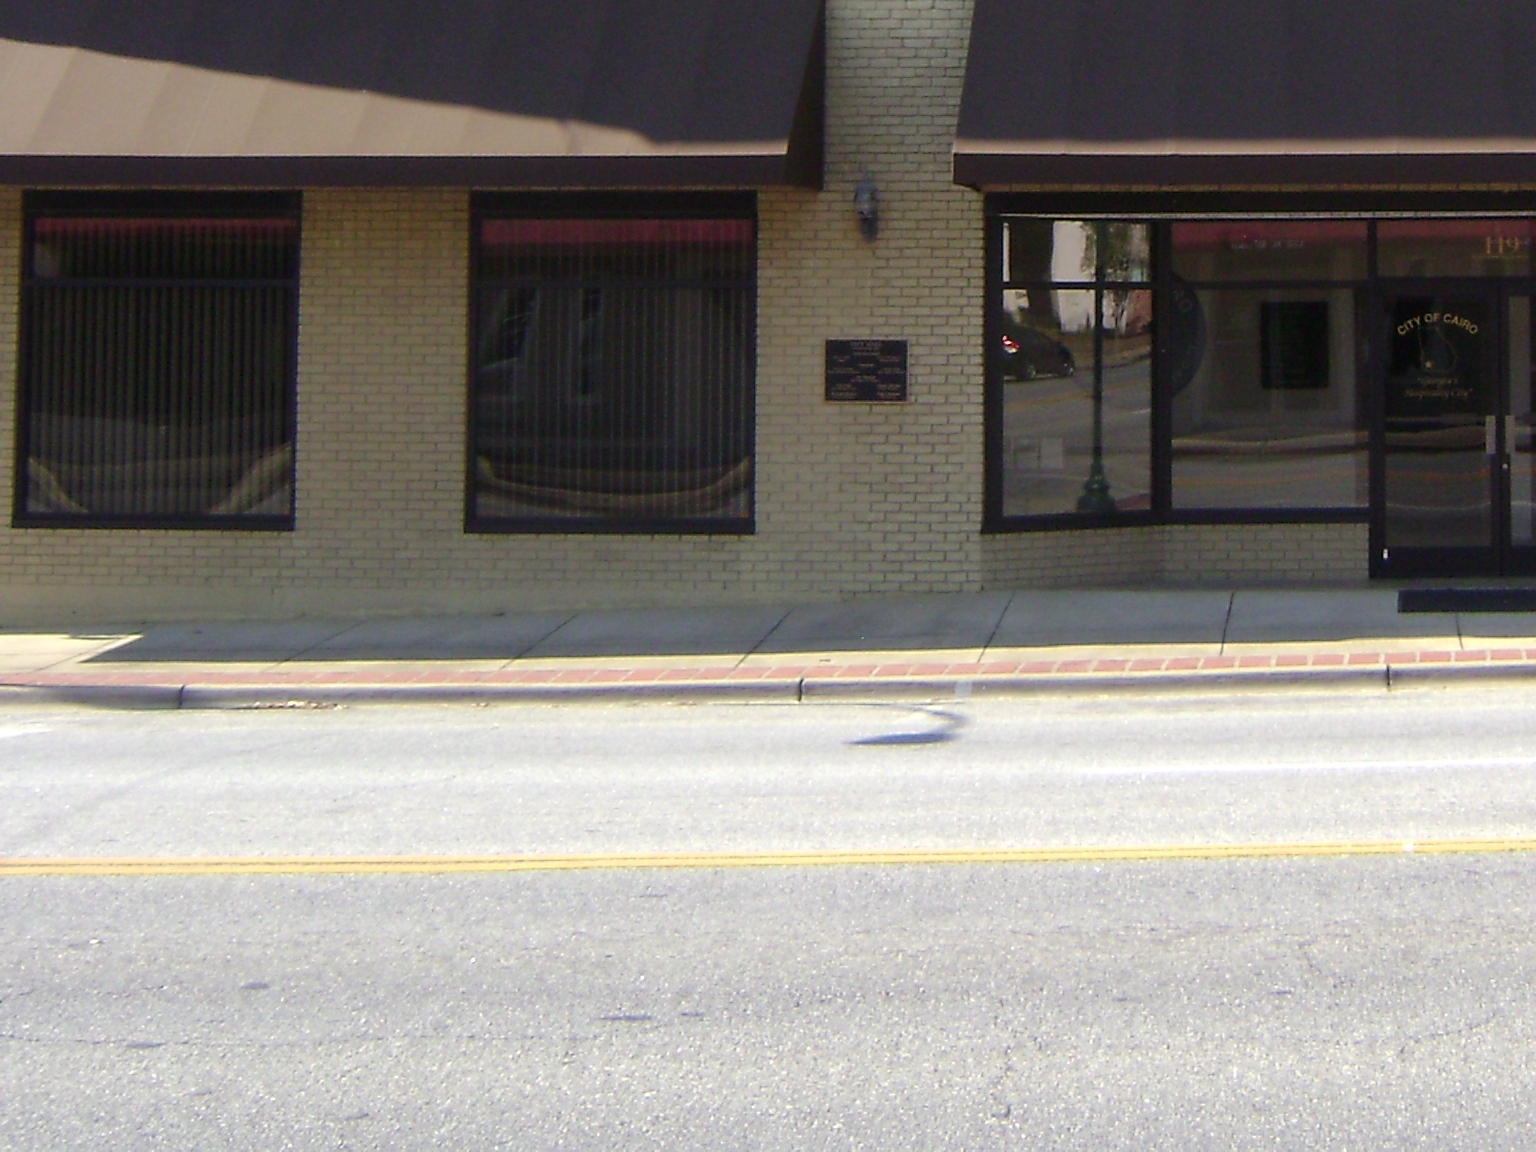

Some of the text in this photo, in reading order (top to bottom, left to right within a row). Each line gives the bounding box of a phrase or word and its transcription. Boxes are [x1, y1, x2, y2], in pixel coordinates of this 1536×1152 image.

[1485, 236, 1520, 255] 119
[1397, 312, 1479, 335] CITY OF CAIRO
